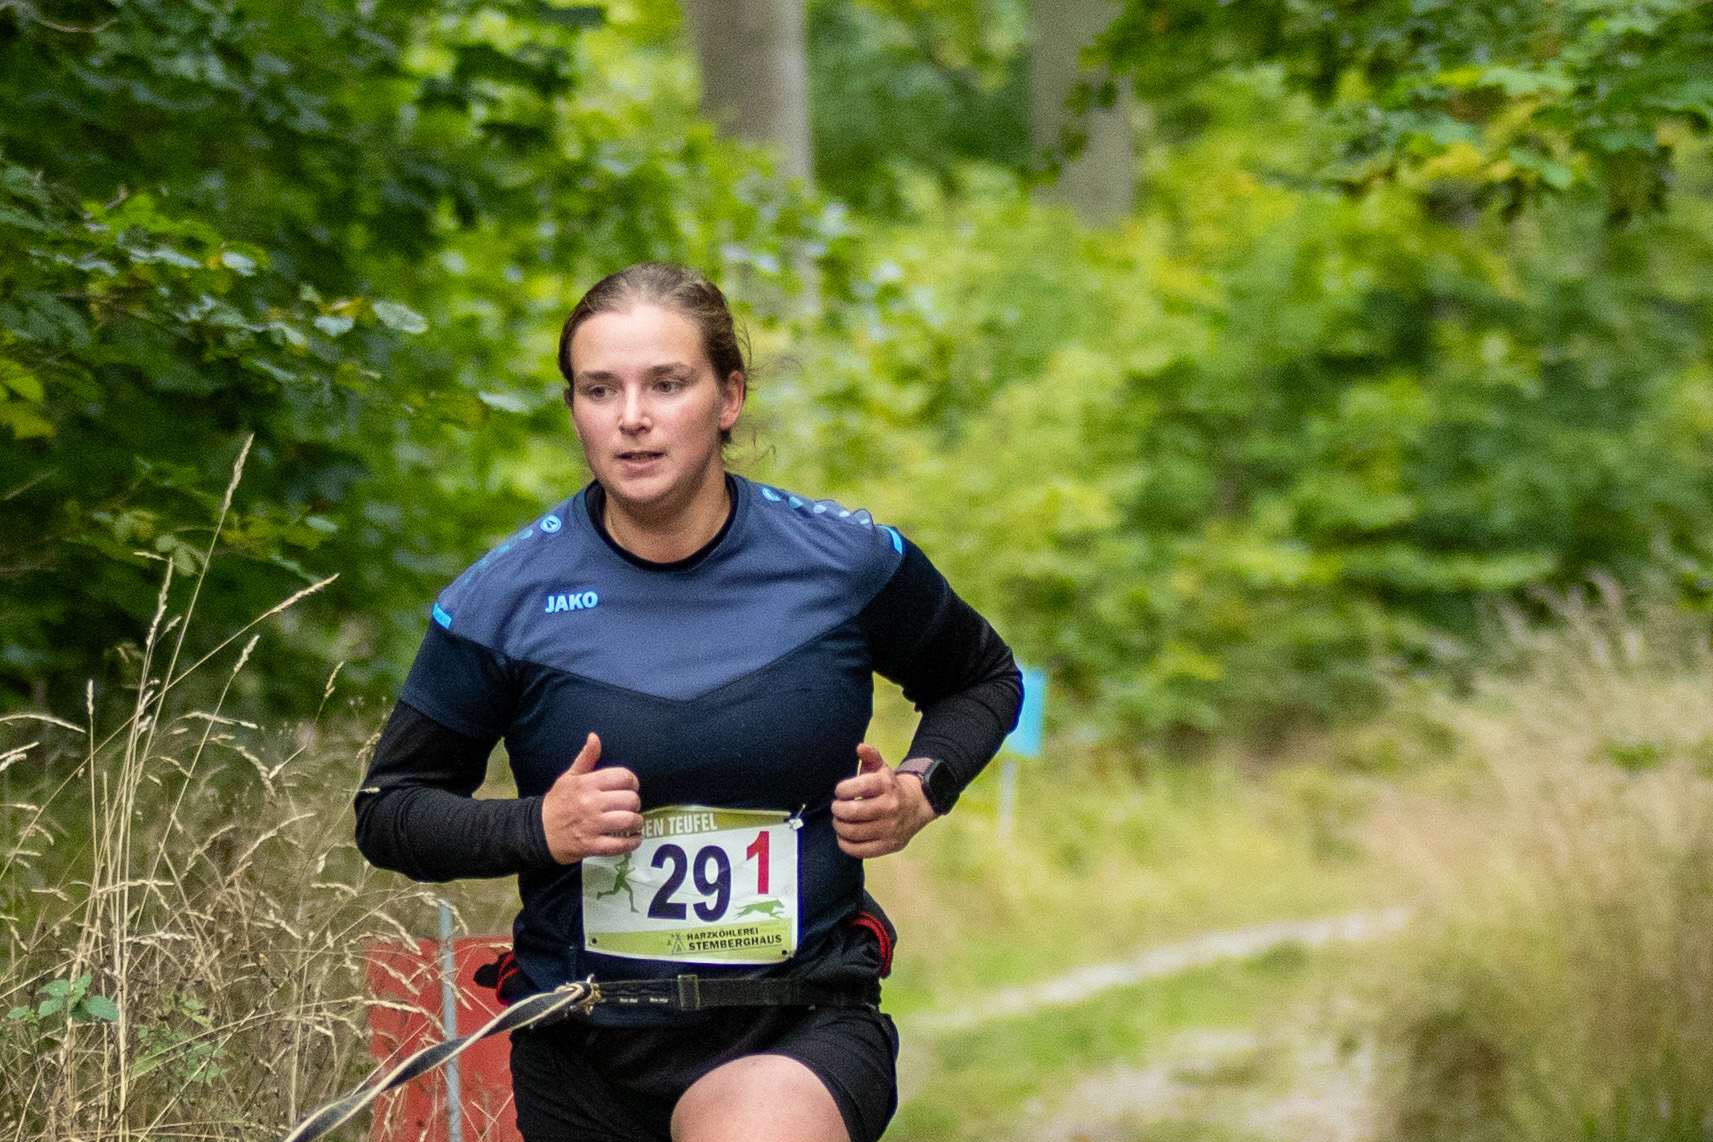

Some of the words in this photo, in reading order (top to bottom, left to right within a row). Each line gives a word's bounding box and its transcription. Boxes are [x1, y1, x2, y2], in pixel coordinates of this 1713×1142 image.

[545, 591, 599, 614] JAKO
[668, 812, 717, 834] TEUFEL
[687, 927, 759, 941] HARZKÖHLEREI
[689, 934, 782, 951] STEMBERGHAUS
